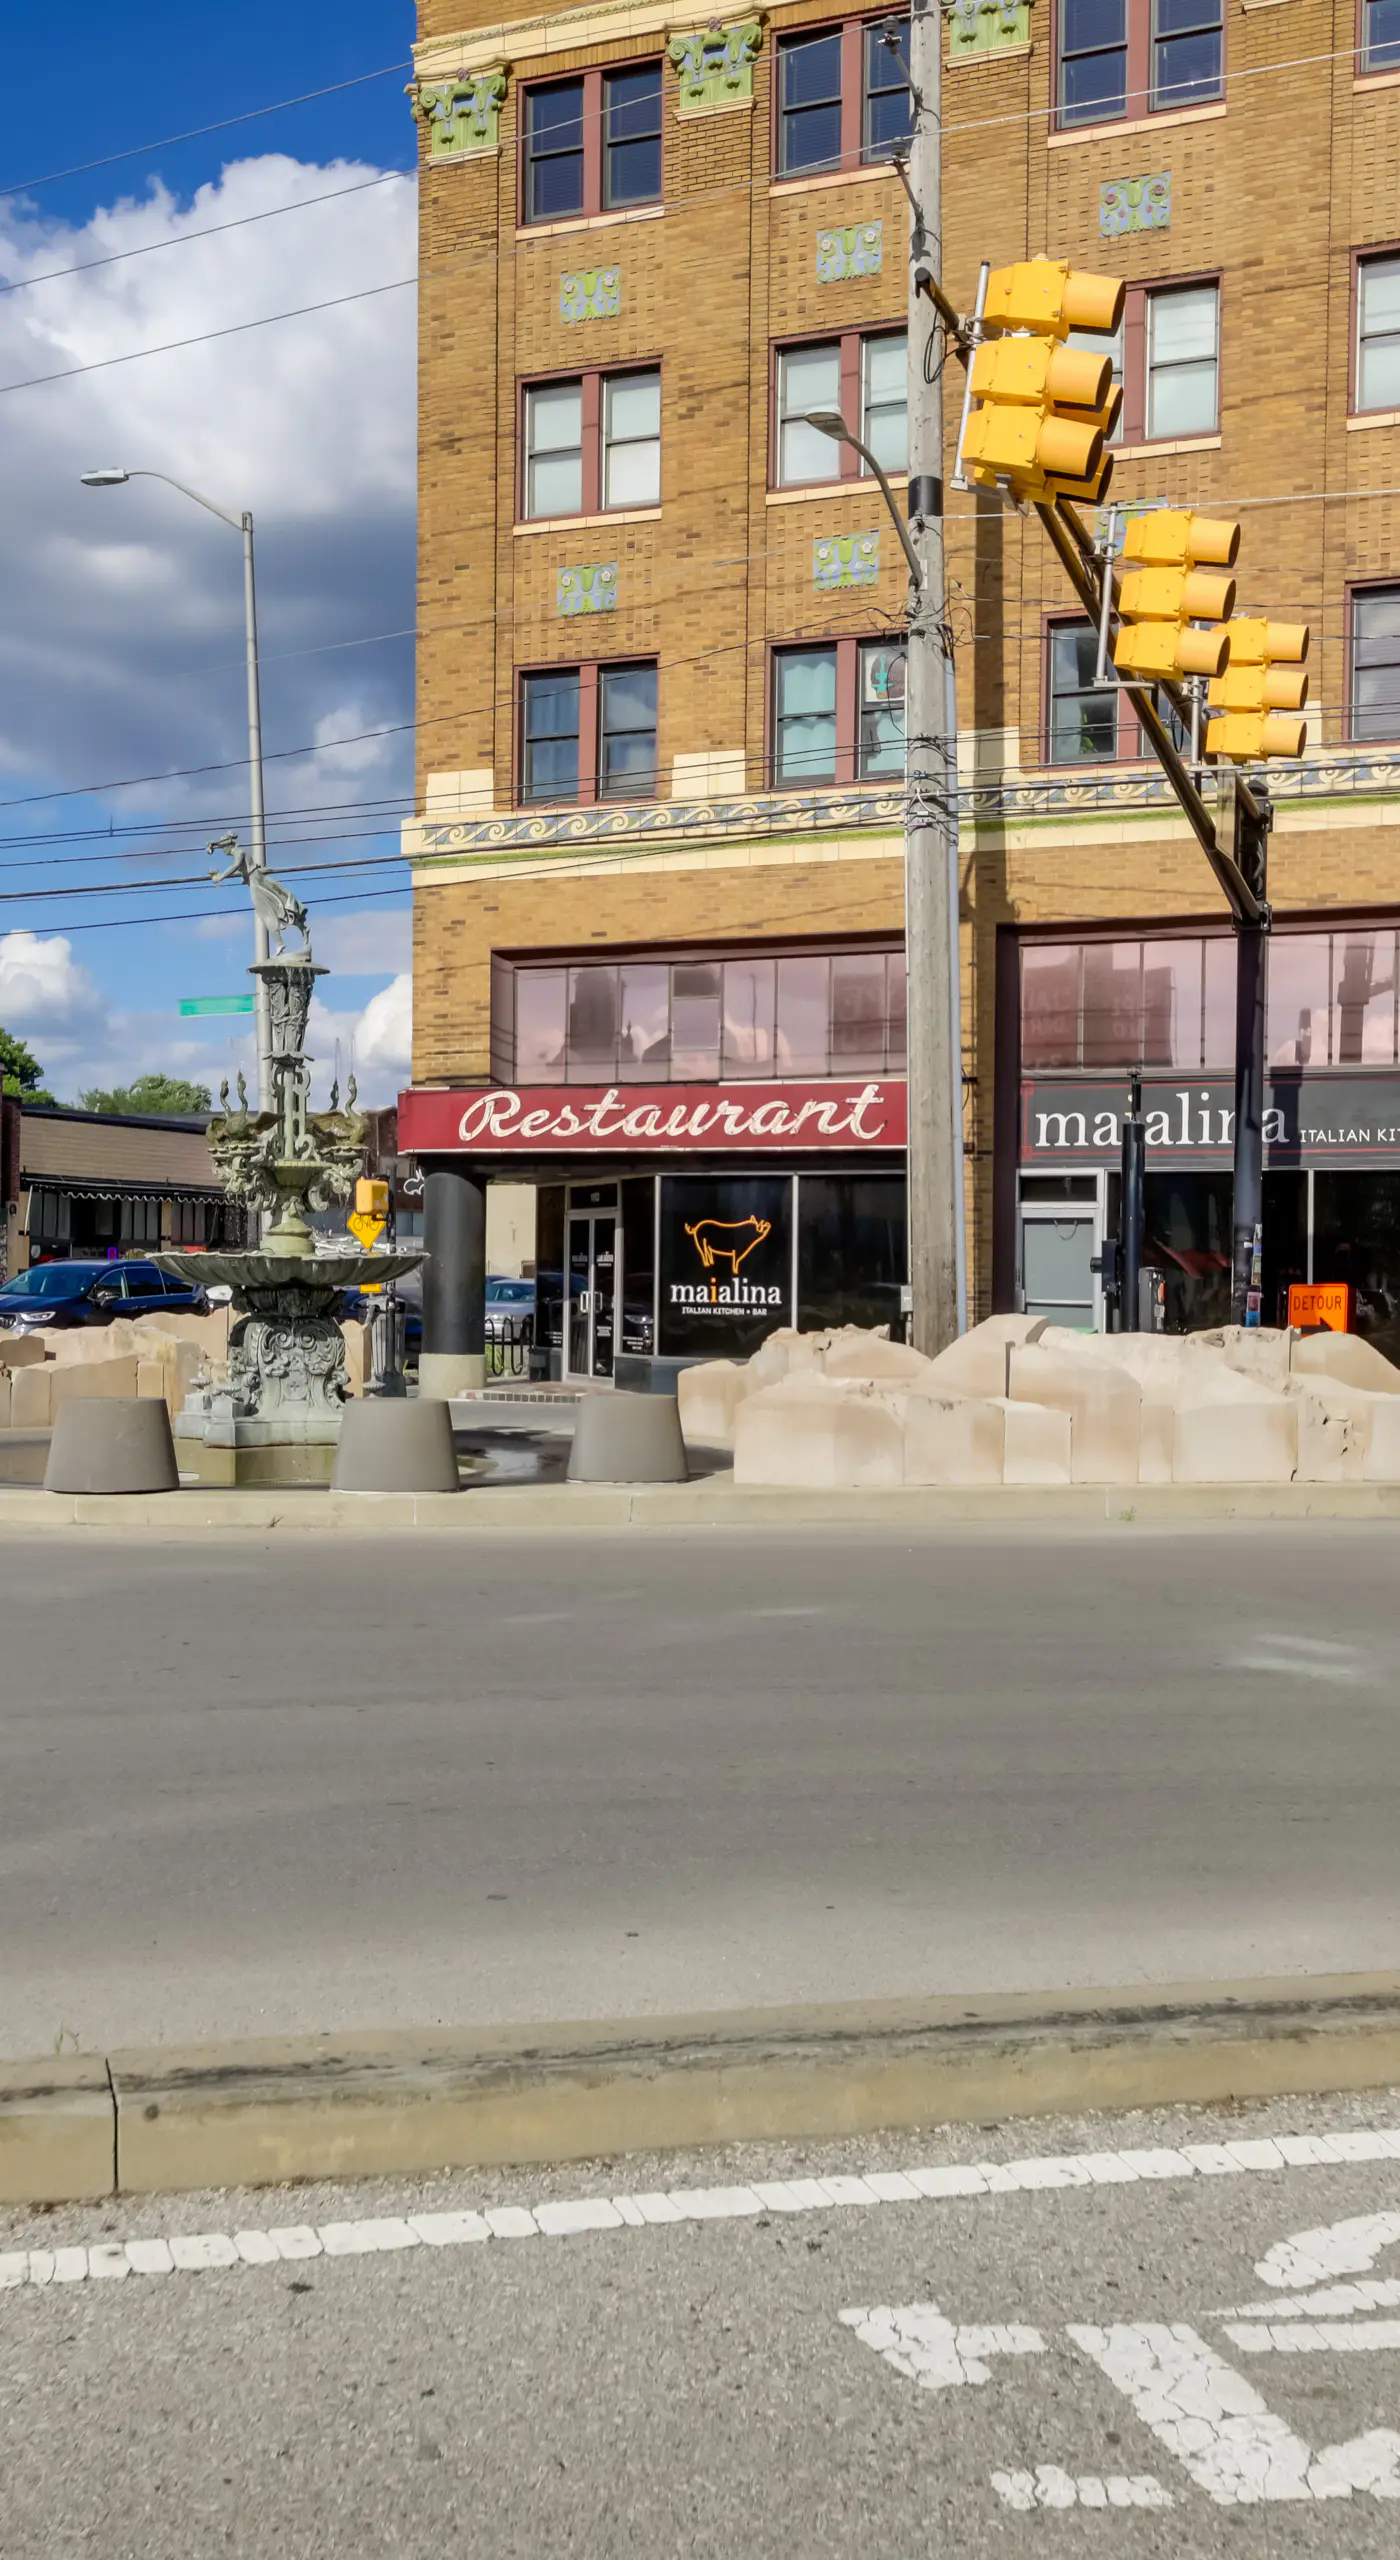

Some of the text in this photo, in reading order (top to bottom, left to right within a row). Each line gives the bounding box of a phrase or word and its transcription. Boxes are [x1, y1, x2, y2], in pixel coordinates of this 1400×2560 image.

[458, 1084, 888, 1141] Restaurant
[1035, 1091, 1290, 1147] maalia
[1300, 1129, 1370, 1143] ITALIAN
[670, 1277, 782, 1304] maialina
[1293, 1296, 1342, 1311] DETOUR
[682, 1307, 767, 1316] ITALIAN KITCHEN BAR
